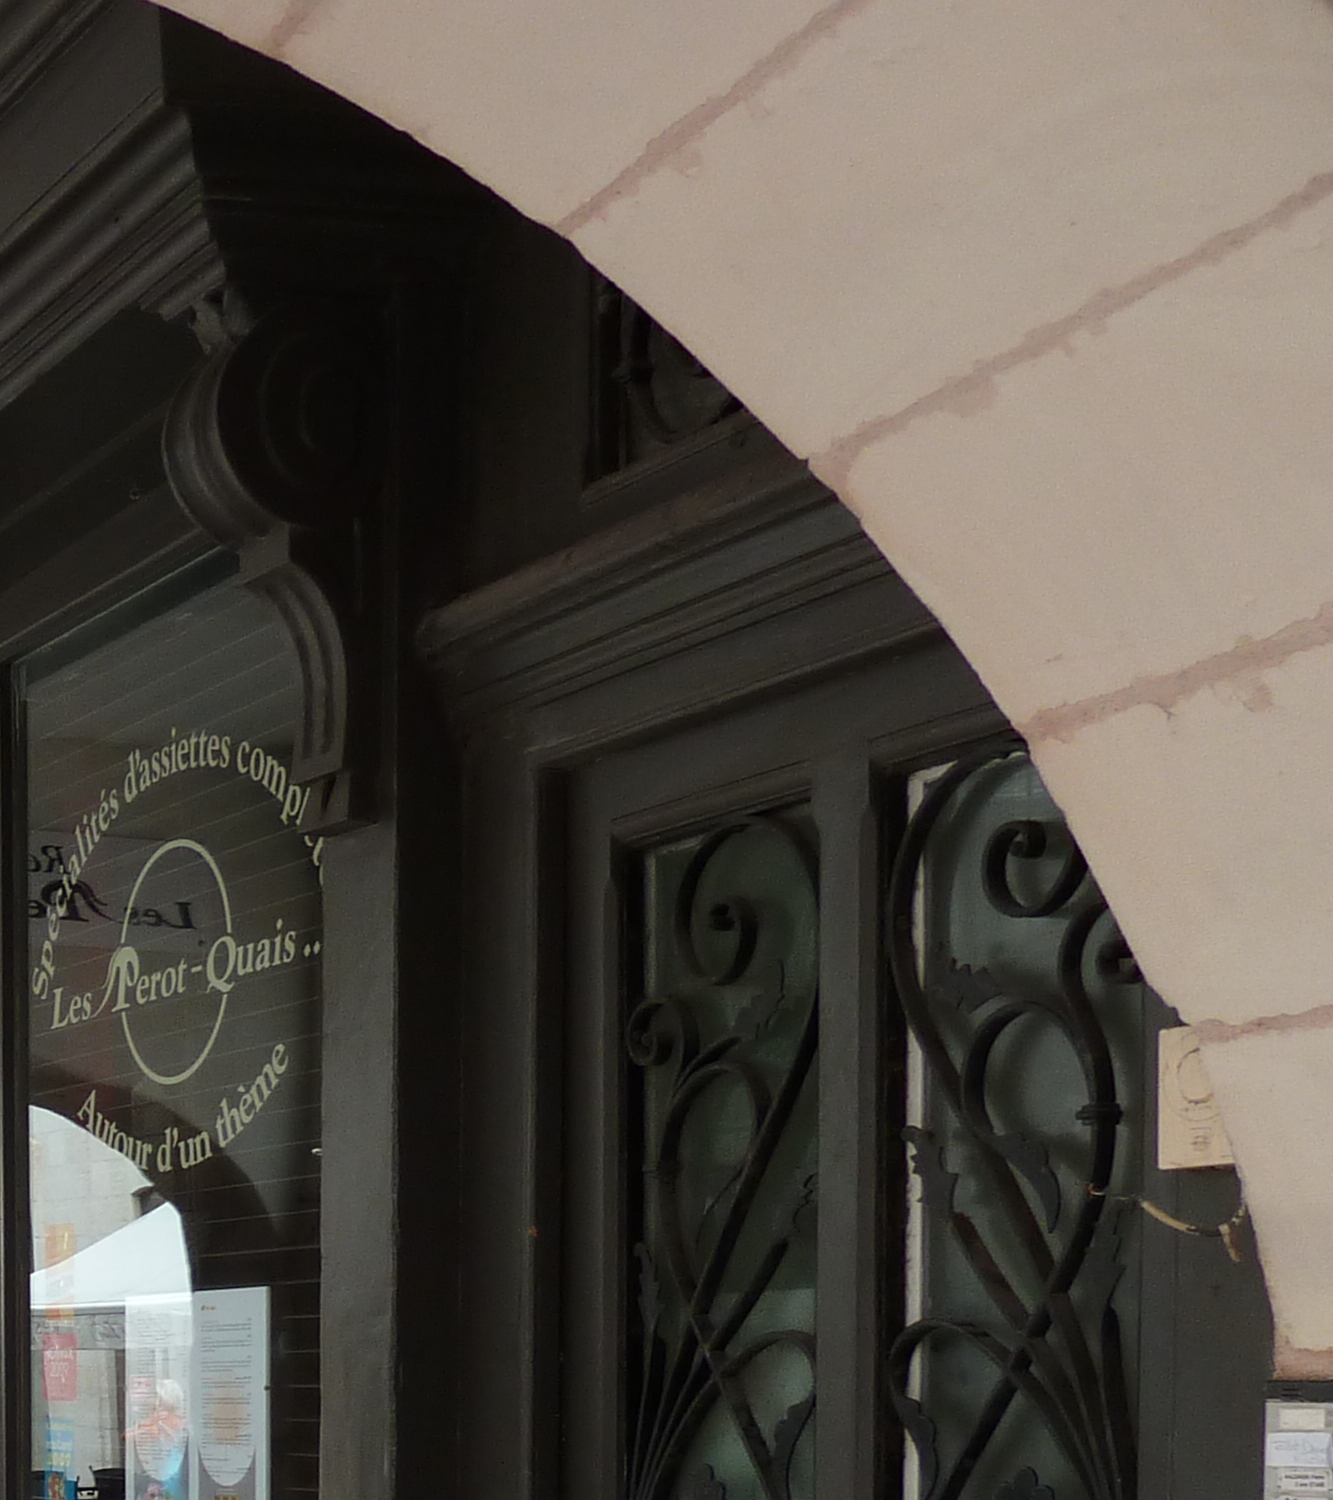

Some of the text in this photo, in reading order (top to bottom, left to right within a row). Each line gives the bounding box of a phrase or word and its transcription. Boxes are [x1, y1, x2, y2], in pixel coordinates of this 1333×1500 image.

[124, 727, 232, 804] d'assiettes
[51, 987, 93, 1030] Les
[76, 1042, 289, 1174] Autour d'un thème
